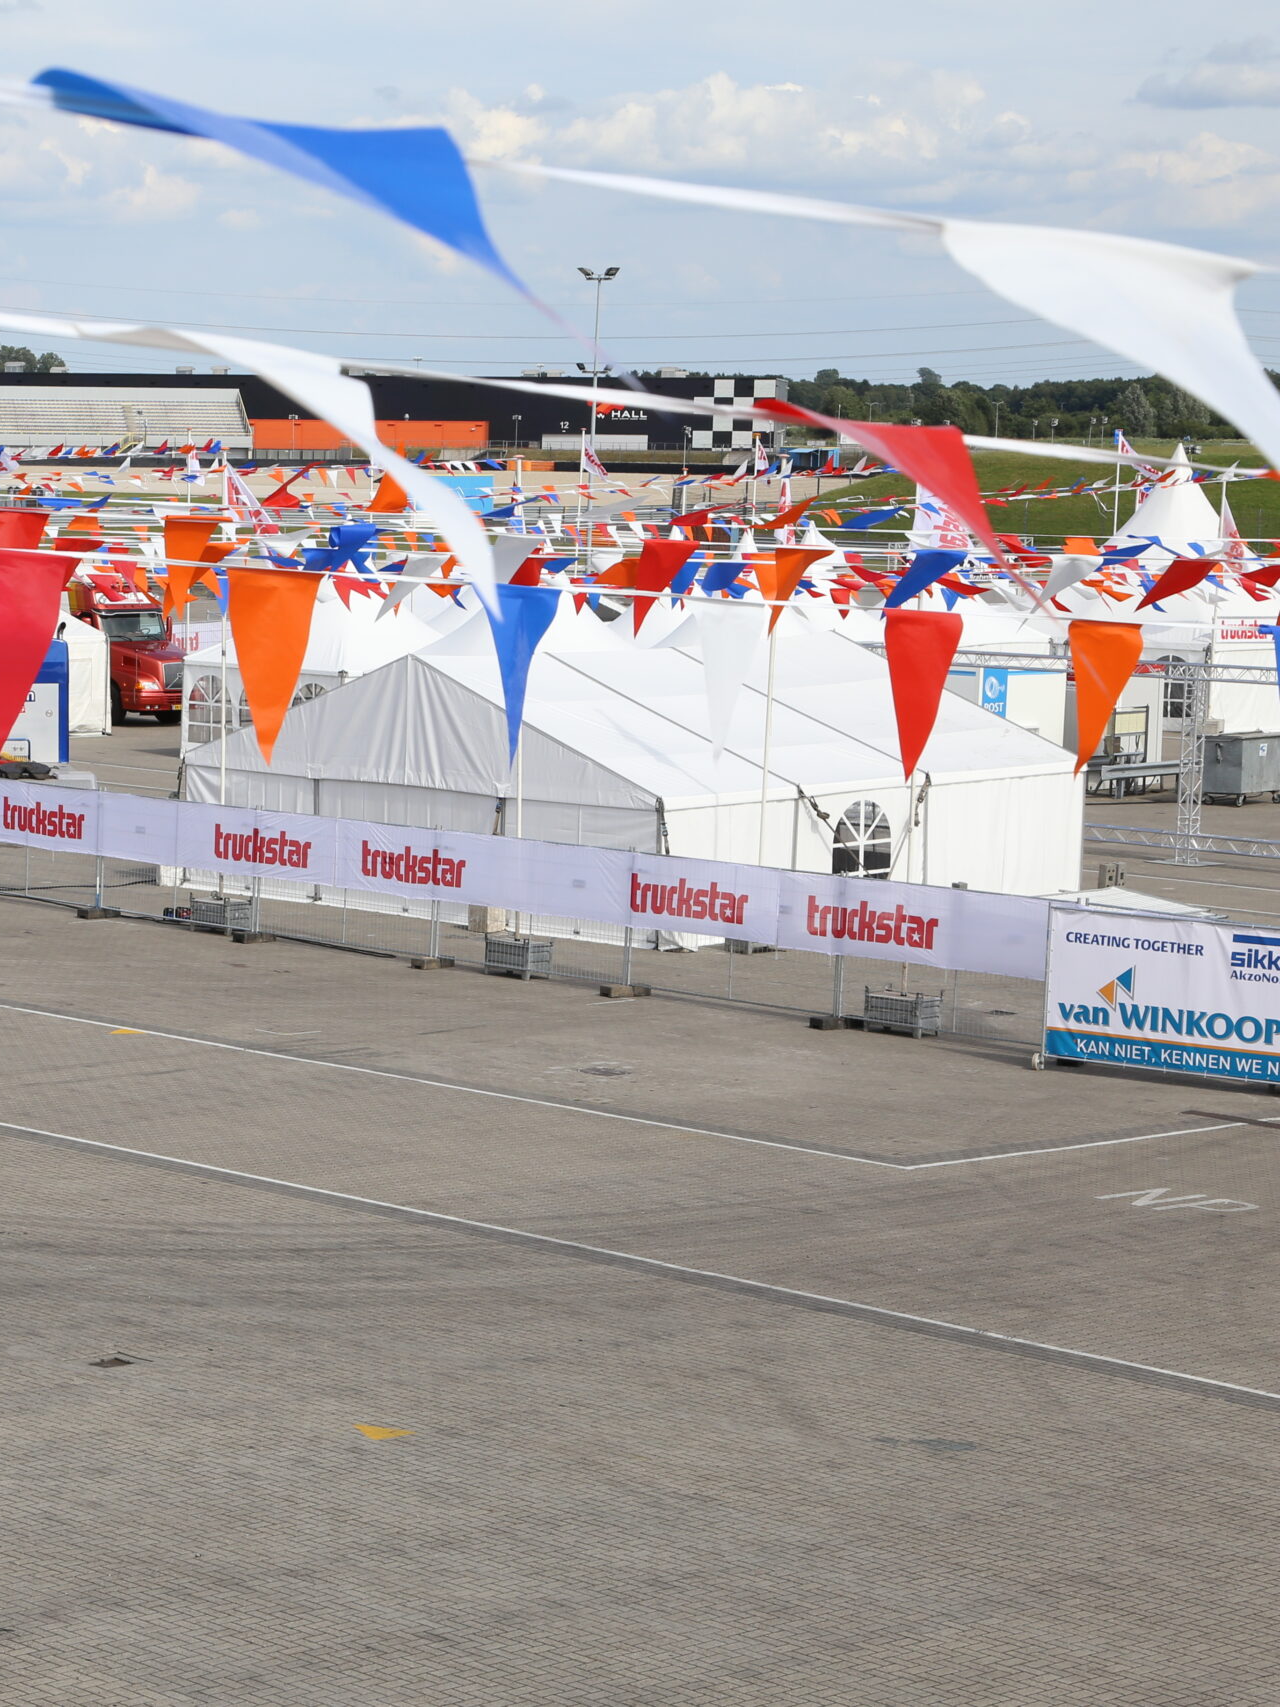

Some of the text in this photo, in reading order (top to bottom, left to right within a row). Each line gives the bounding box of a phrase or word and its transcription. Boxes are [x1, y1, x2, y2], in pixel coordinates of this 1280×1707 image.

[560, 421, 569, 429] 12
[611, 410, 648, 418] HALL
[2, 795, 85, 840] truckstar
[214, 823, 312, 869] truckstar
[361, 839, 466, 888] truckstar
[630, 872, 749, 925] truckstar
[806, 894, 939, 950] truckstar
[1065, 931, 1204, 957] CREATING TOGETHER
[1057, 1002, 1110, 1027] van
[1076, 1038, 1110, 1056] KAN
[1114, 1043, 1155, 1064] NIET,
[1160, 1048, 1231, 1071] KENNEN
[1235, 1057, 1263, 1074] WE
